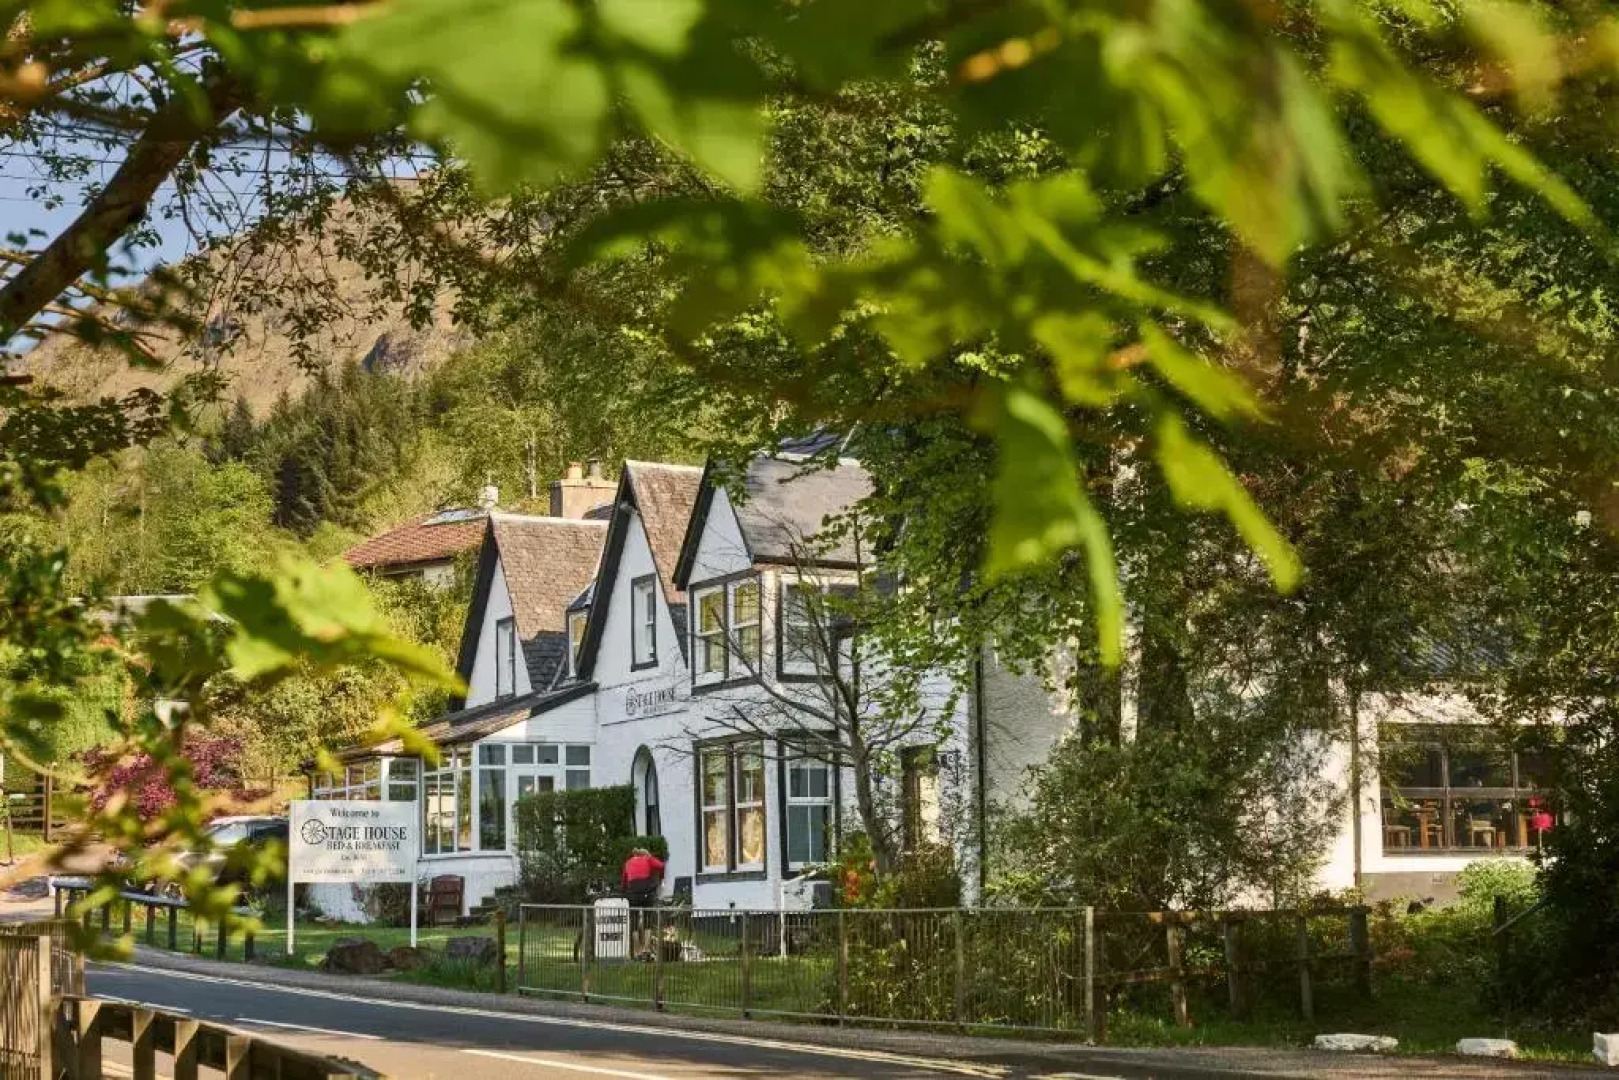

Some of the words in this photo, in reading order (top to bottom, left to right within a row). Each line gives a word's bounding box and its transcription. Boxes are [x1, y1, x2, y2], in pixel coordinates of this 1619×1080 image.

[330, 807, 369, 818] Welcome
[371, 809, 380, 818] to
[324, 826, 360, 840] STAGE
[364, 826, 407, 840] HOUSE
[326, 841, 344, 850] BED
[345, 841, 353, 850] &
[355, 841, 400, 850] BREAKFAST
